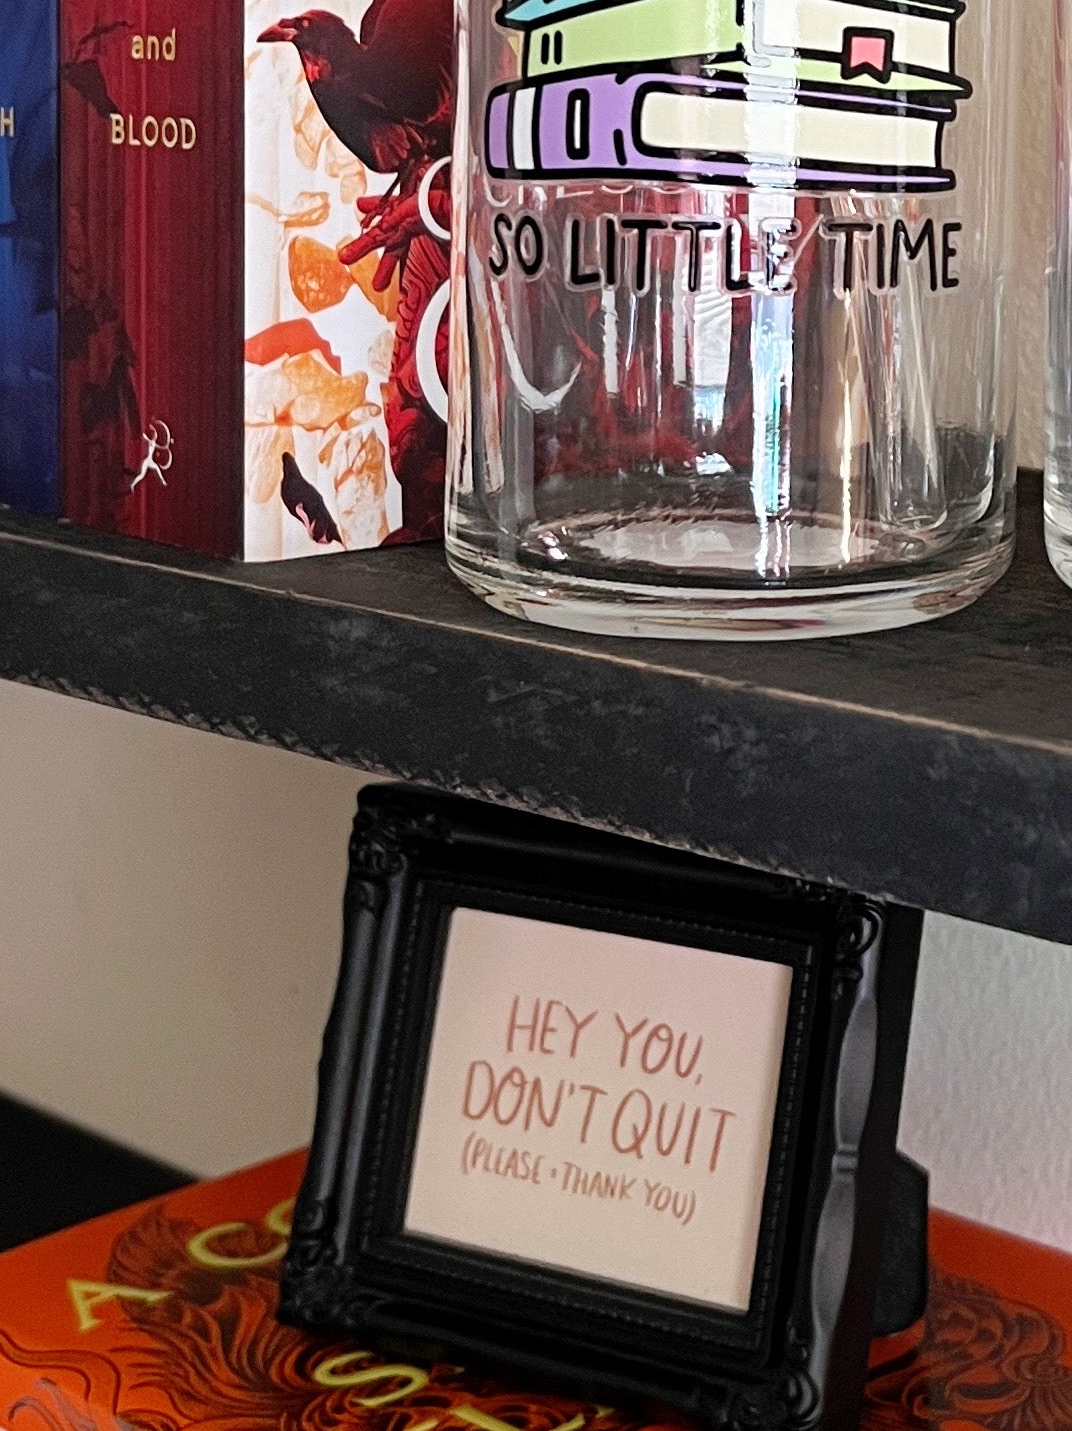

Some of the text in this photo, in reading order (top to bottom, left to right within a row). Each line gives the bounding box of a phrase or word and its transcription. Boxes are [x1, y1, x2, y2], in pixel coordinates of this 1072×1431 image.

[131, 28, 177, 60] and
[110, 113, 196, 151] BLOOD
[489, 214, 963, 292] SO LITTLE TIME
[506, 995, 704, 1085] HEY YOU,
[462, 1060, 737, 1172] DON'T QUIT
[461, 1131, 697, 1226] (PLEASE THANK YOU)
